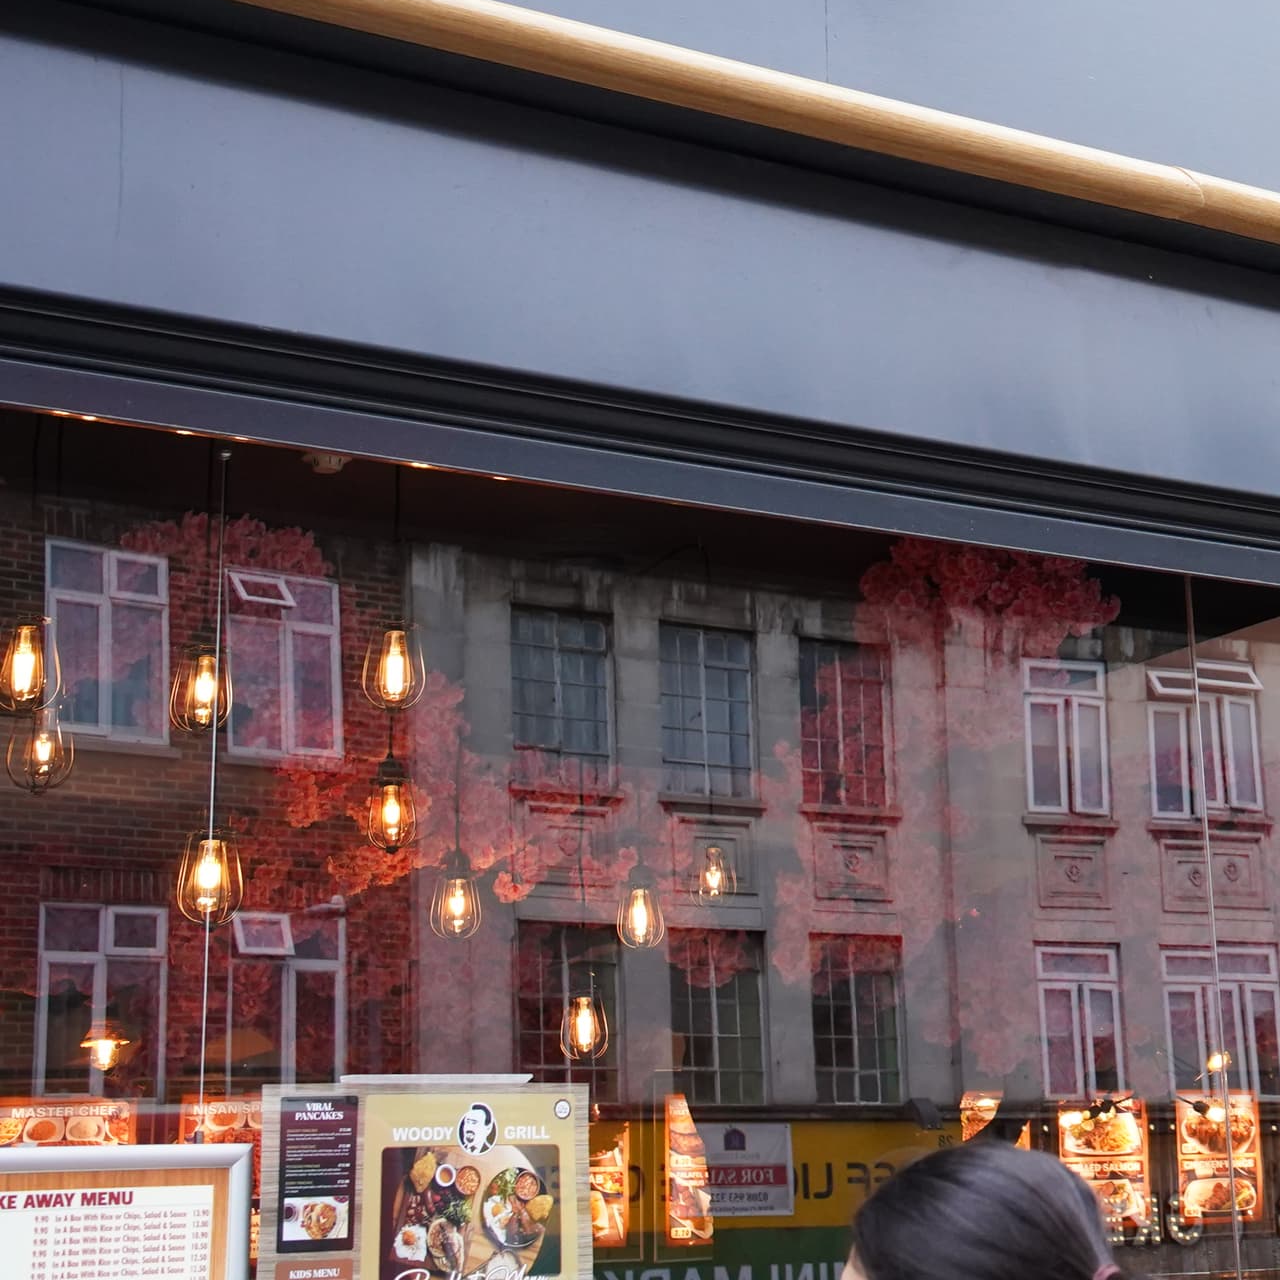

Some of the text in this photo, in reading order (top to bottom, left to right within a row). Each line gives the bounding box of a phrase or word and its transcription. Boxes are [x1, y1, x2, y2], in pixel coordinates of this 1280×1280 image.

[11, 1105, 118, 1119] MASTER CHEF
[193, 1103, 238, 1115] NISAN
[305, 1102, 335, 1111] VIRAL
[294, 1111, 344, 1121] PANCAKES
[392, 1126, 551, 1142] WOODY GRILL
[23, 1193, 75, 1209] AWAY
[80, 1191, 134, 1207] MENU
[289, 1267, 341, 1280] KIDS MENU
